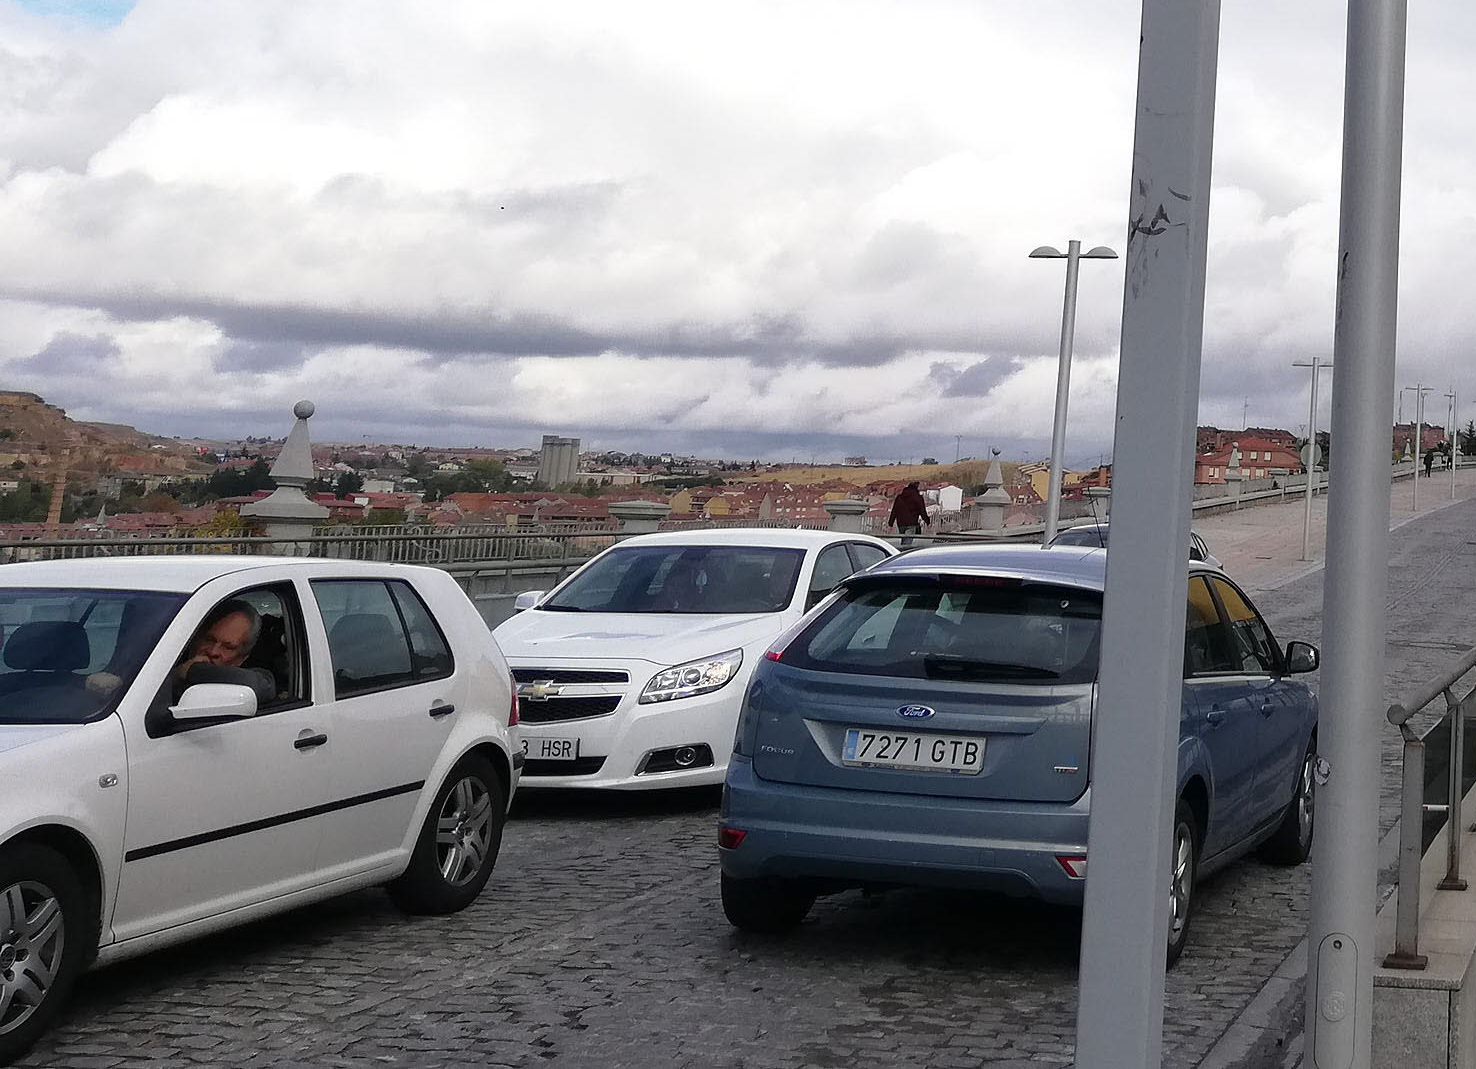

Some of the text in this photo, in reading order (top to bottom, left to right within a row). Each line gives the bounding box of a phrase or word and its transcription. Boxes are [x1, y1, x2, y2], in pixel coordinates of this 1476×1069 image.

[903, 706, 926, 717] Ford
[541, 740, 571, 757] HSR
[858, 734, 980, 766] 7271 GTB
